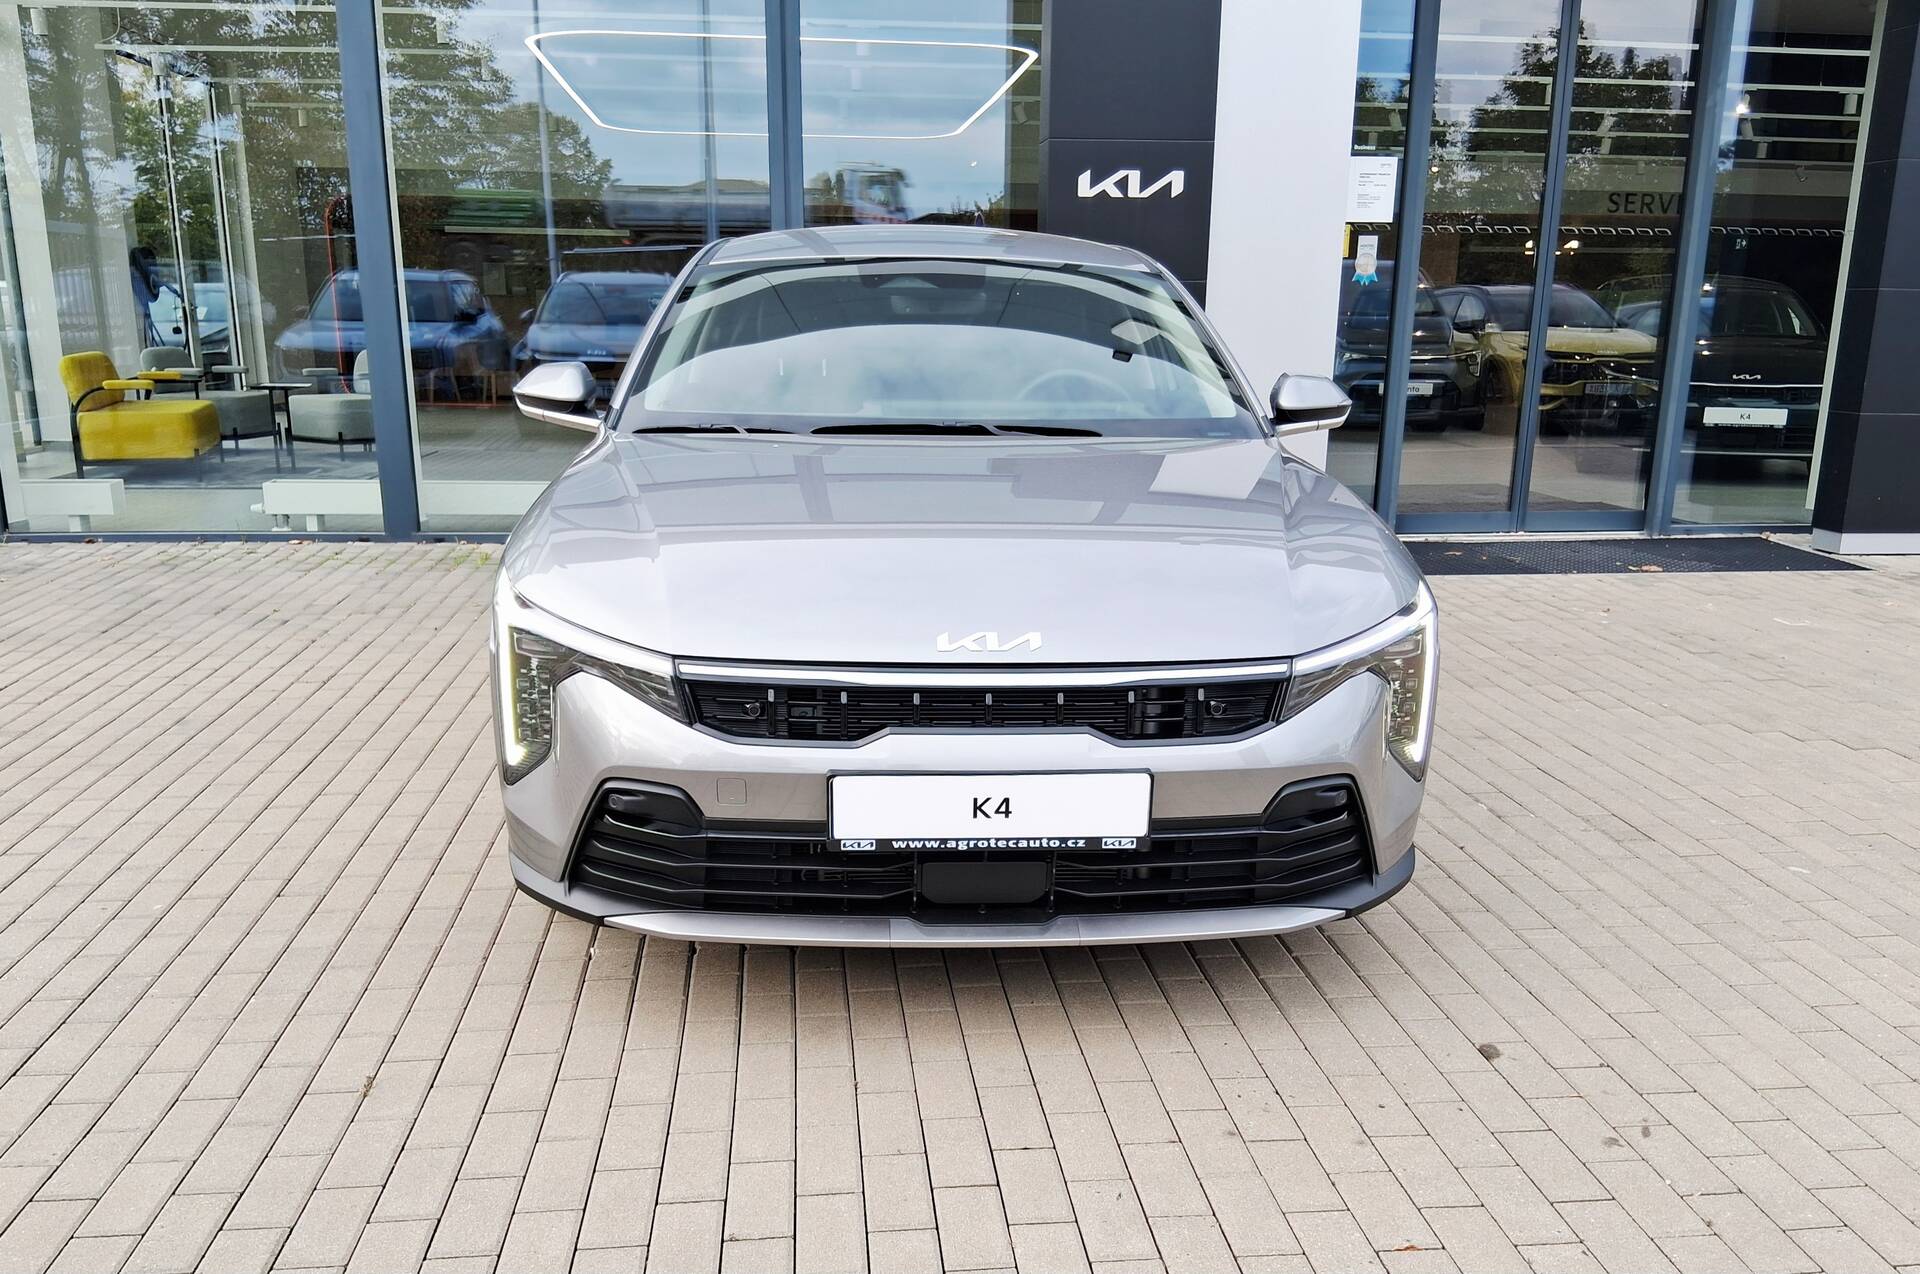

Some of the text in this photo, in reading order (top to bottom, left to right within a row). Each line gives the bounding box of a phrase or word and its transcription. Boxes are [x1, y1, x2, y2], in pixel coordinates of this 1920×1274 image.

[1078, 169, 1184, 198] KIA
[1607, 192, 1681, 214] SERVI
[937, 632, 1041, 652] KIA
[973, 797, 1012, 819] K4
[843, 841, 874, 849] KIA
[892, 838, 1086, 851] www.agrotecauto.cz
[1104, 839, 1134, 847] KIA
